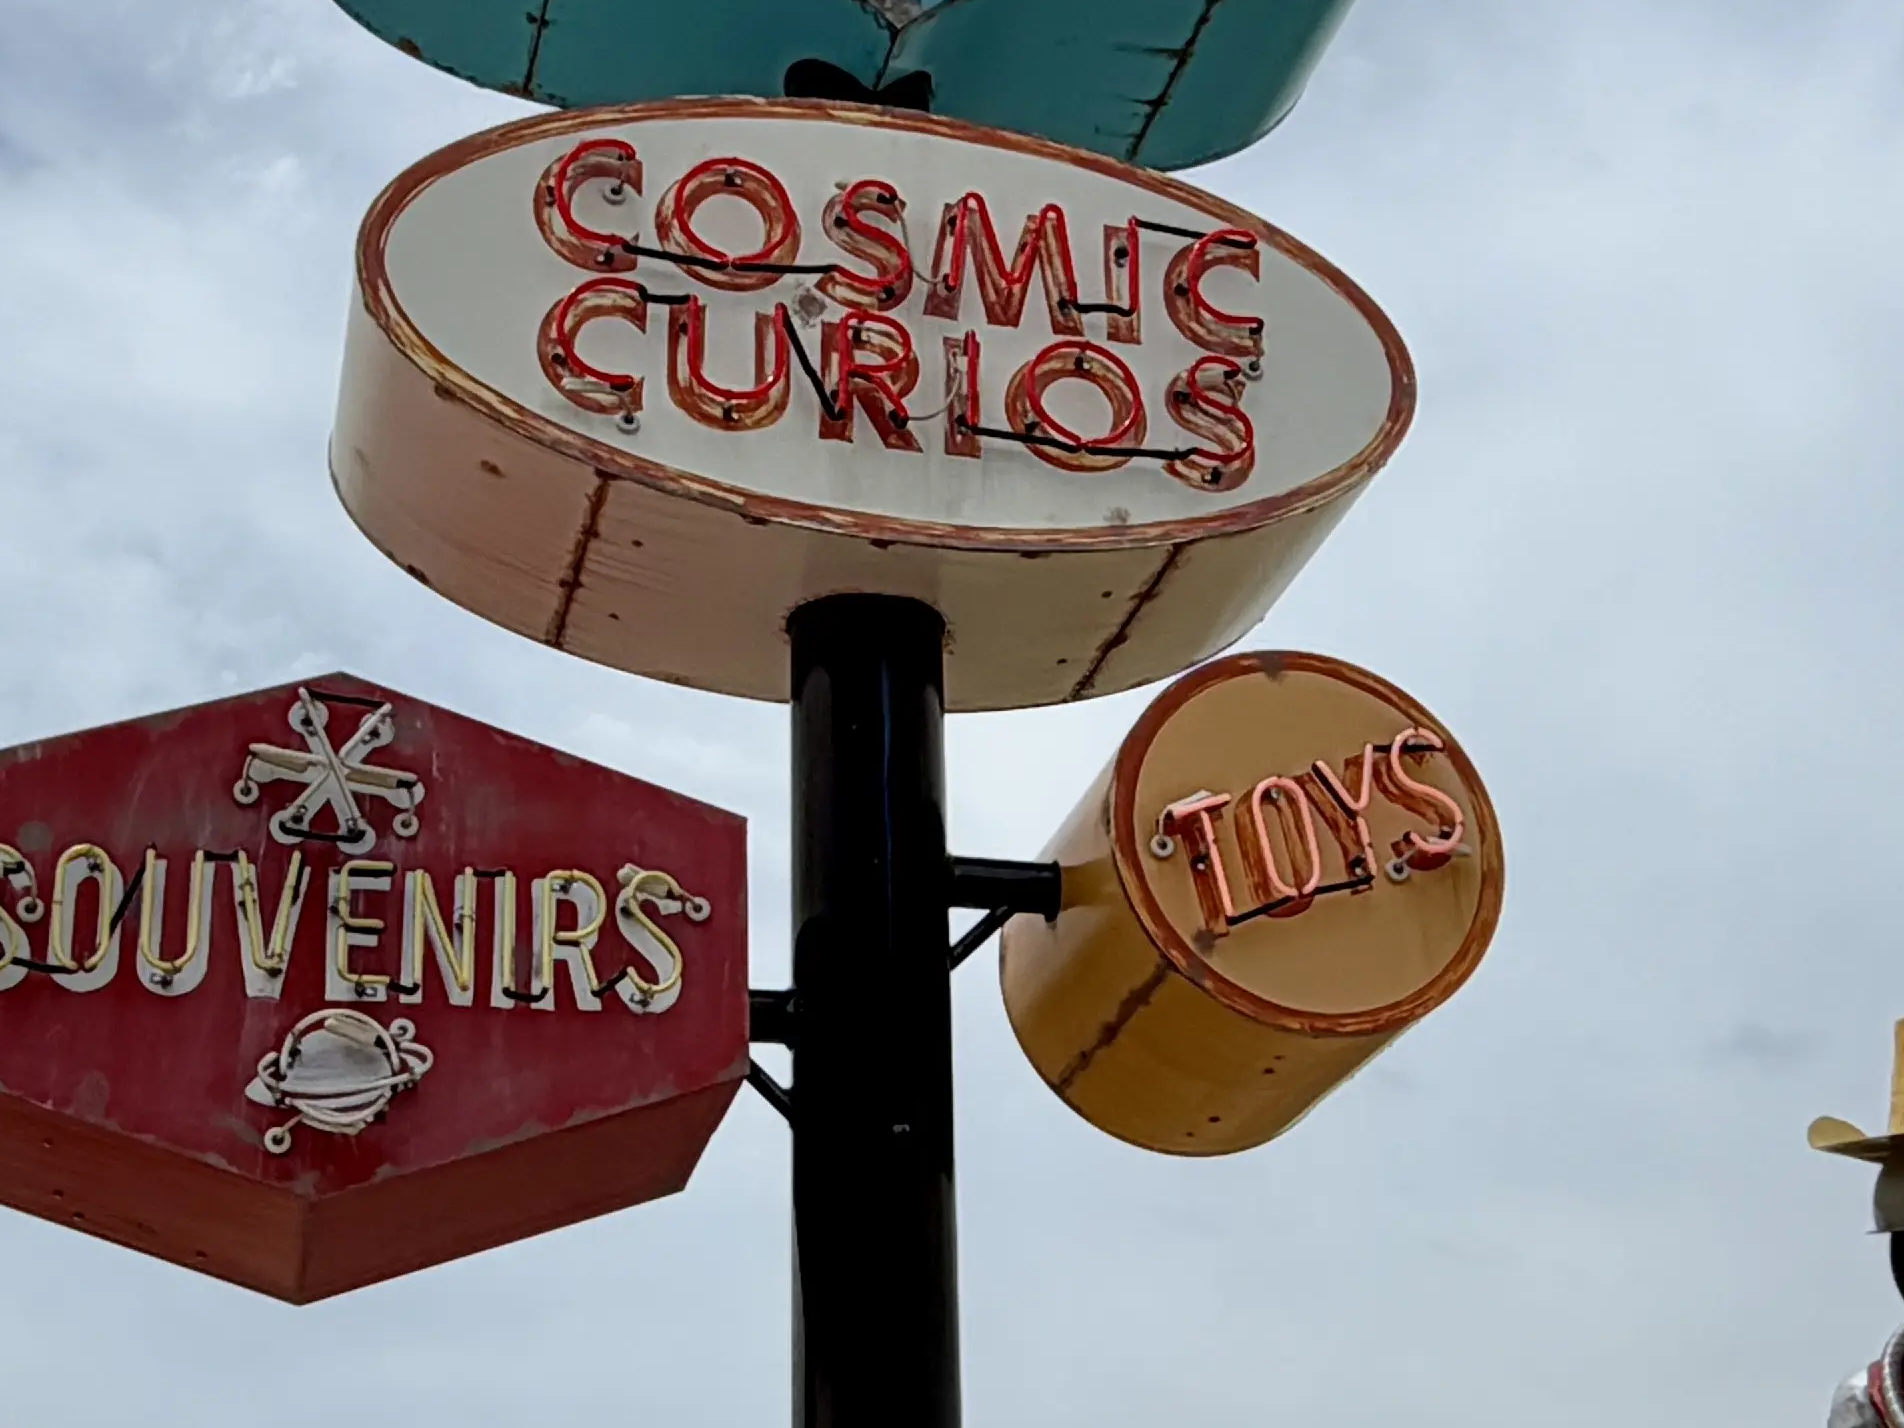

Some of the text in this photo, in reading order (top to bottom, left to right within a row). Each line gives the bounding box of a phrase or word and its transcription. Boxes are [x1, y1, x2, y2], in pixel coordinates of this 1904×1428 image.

[533, 138, 1262, 358] COSMIC
[537, 276, 1257, 493] CURIOS
[1158, 726, 1470, 941] TOYS
